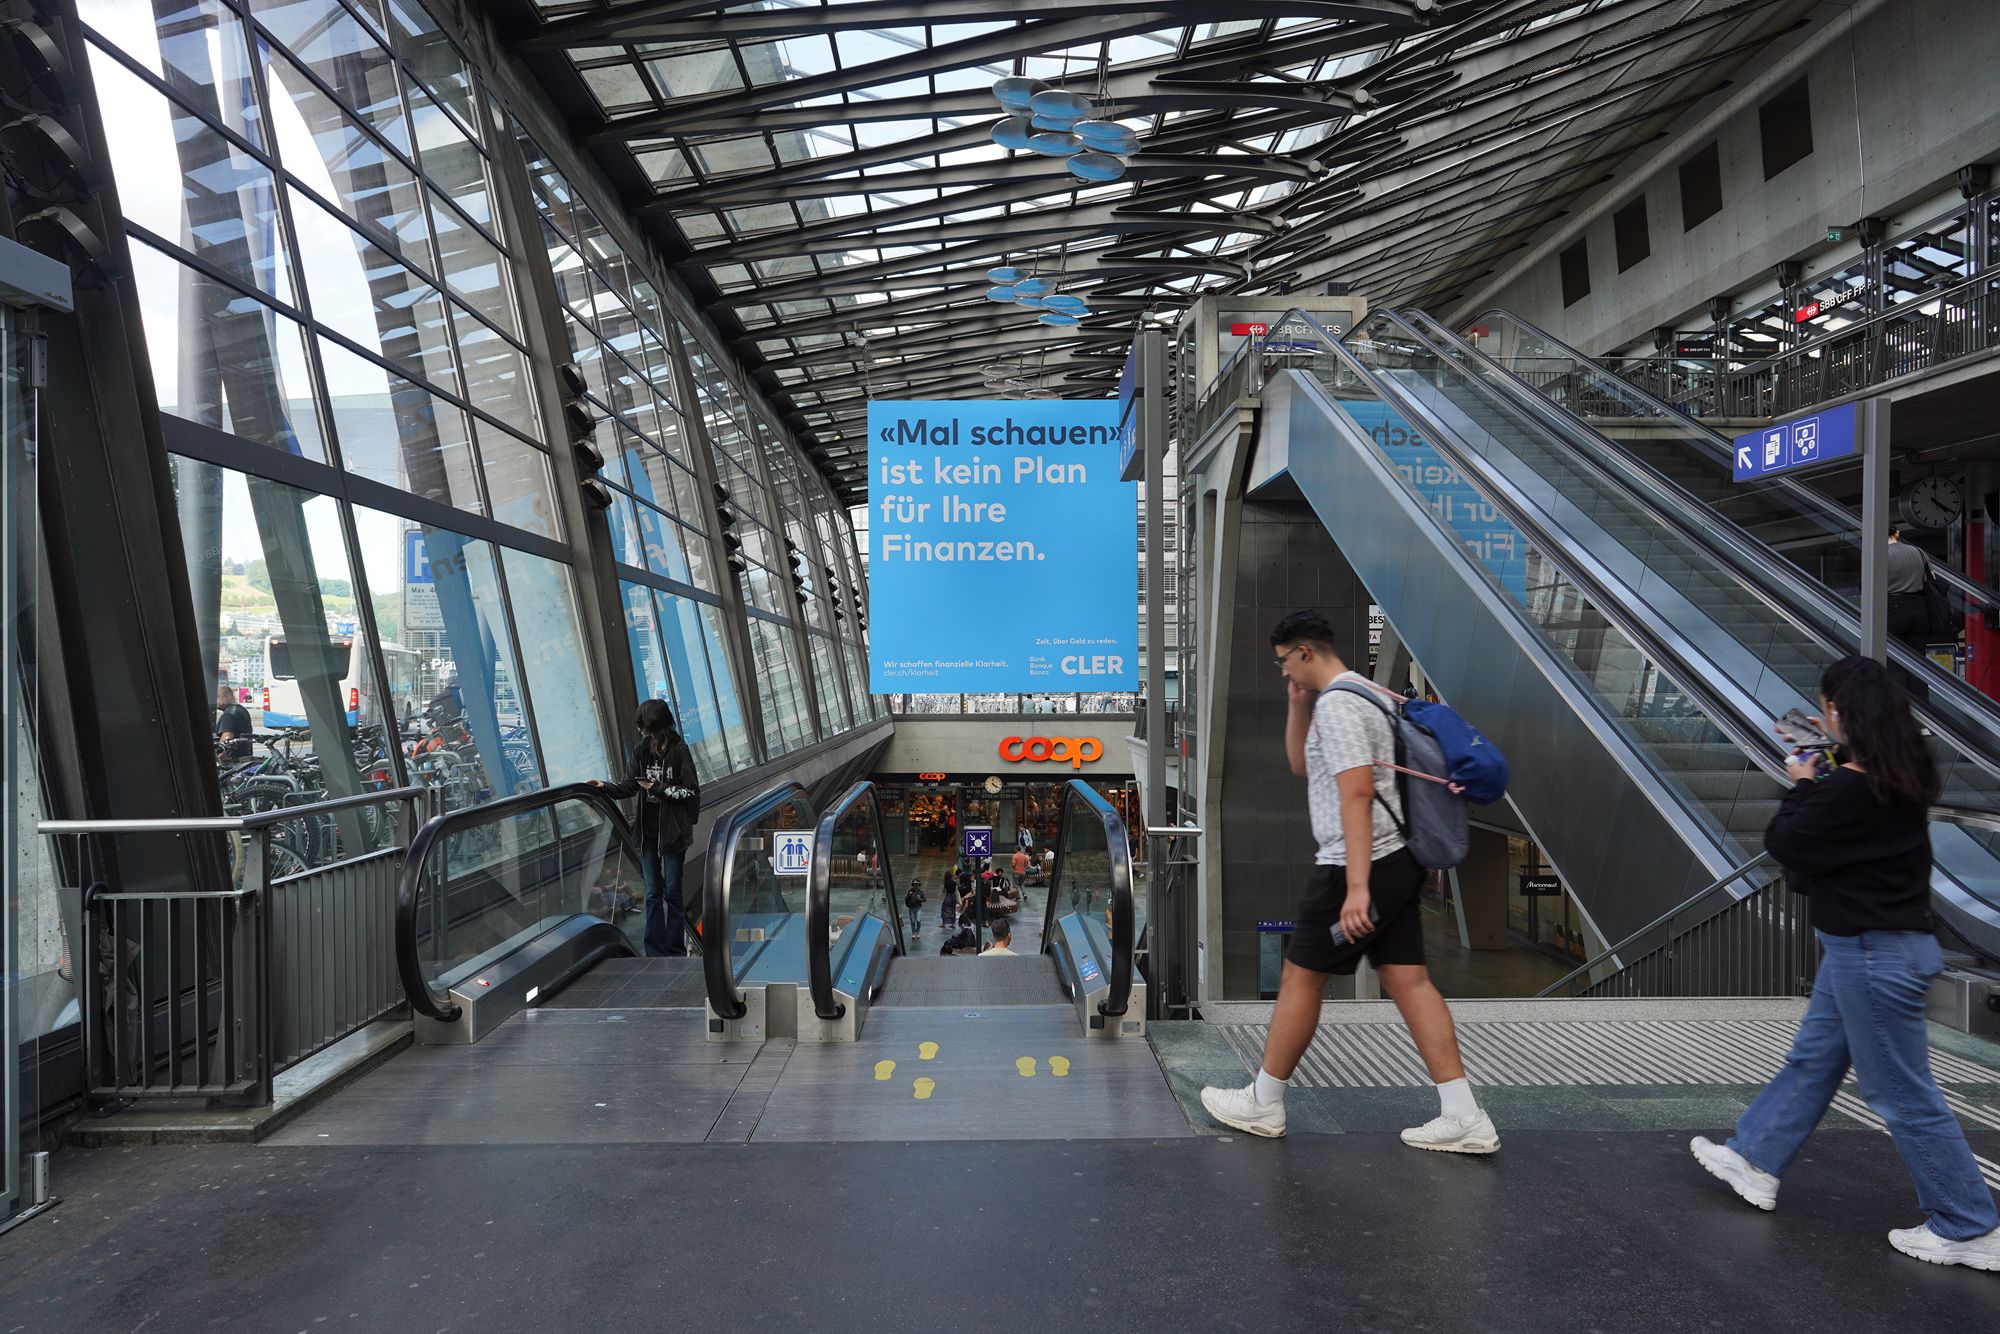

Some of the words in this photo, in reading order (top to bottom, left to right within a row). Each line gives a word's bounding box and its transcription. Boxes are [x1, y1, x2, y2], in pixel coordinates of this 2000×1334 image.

[1820, 297, 1836, 312] SBB
[1836, 288, 1853, 304] CFF
[1294, 325, 1313, 335] CF
[1326, 325, 1341, 335] FS
[880, 418, 959, 446] «Mal
[970, 418, 1123, 446] schauen»
[880, 456, 924, 485] ist
[934, 456, 1001, 485] kein
[1014, 456, 1086, 484] Plan
[880, 495, 931, 524] für
[942, 496, 1007, 524] Ihre
[882, 534, 1046, 562] Finanzen.
[883, 660, 897, 668] Wir
[900, 660, 933, 668] schaffen
[935, 660, 974, 668] finanzielle
[975, 660, 1009, 668] Klarheit.
[883, 668, 939, 677] cler.ch/klarheit
[1061, 655, 1124, 675] CLER
[999, 736, 1103, 768] coop
[919, 772, 945, 782] coop
[1526, 881, 1558, 889] Marionnaud
